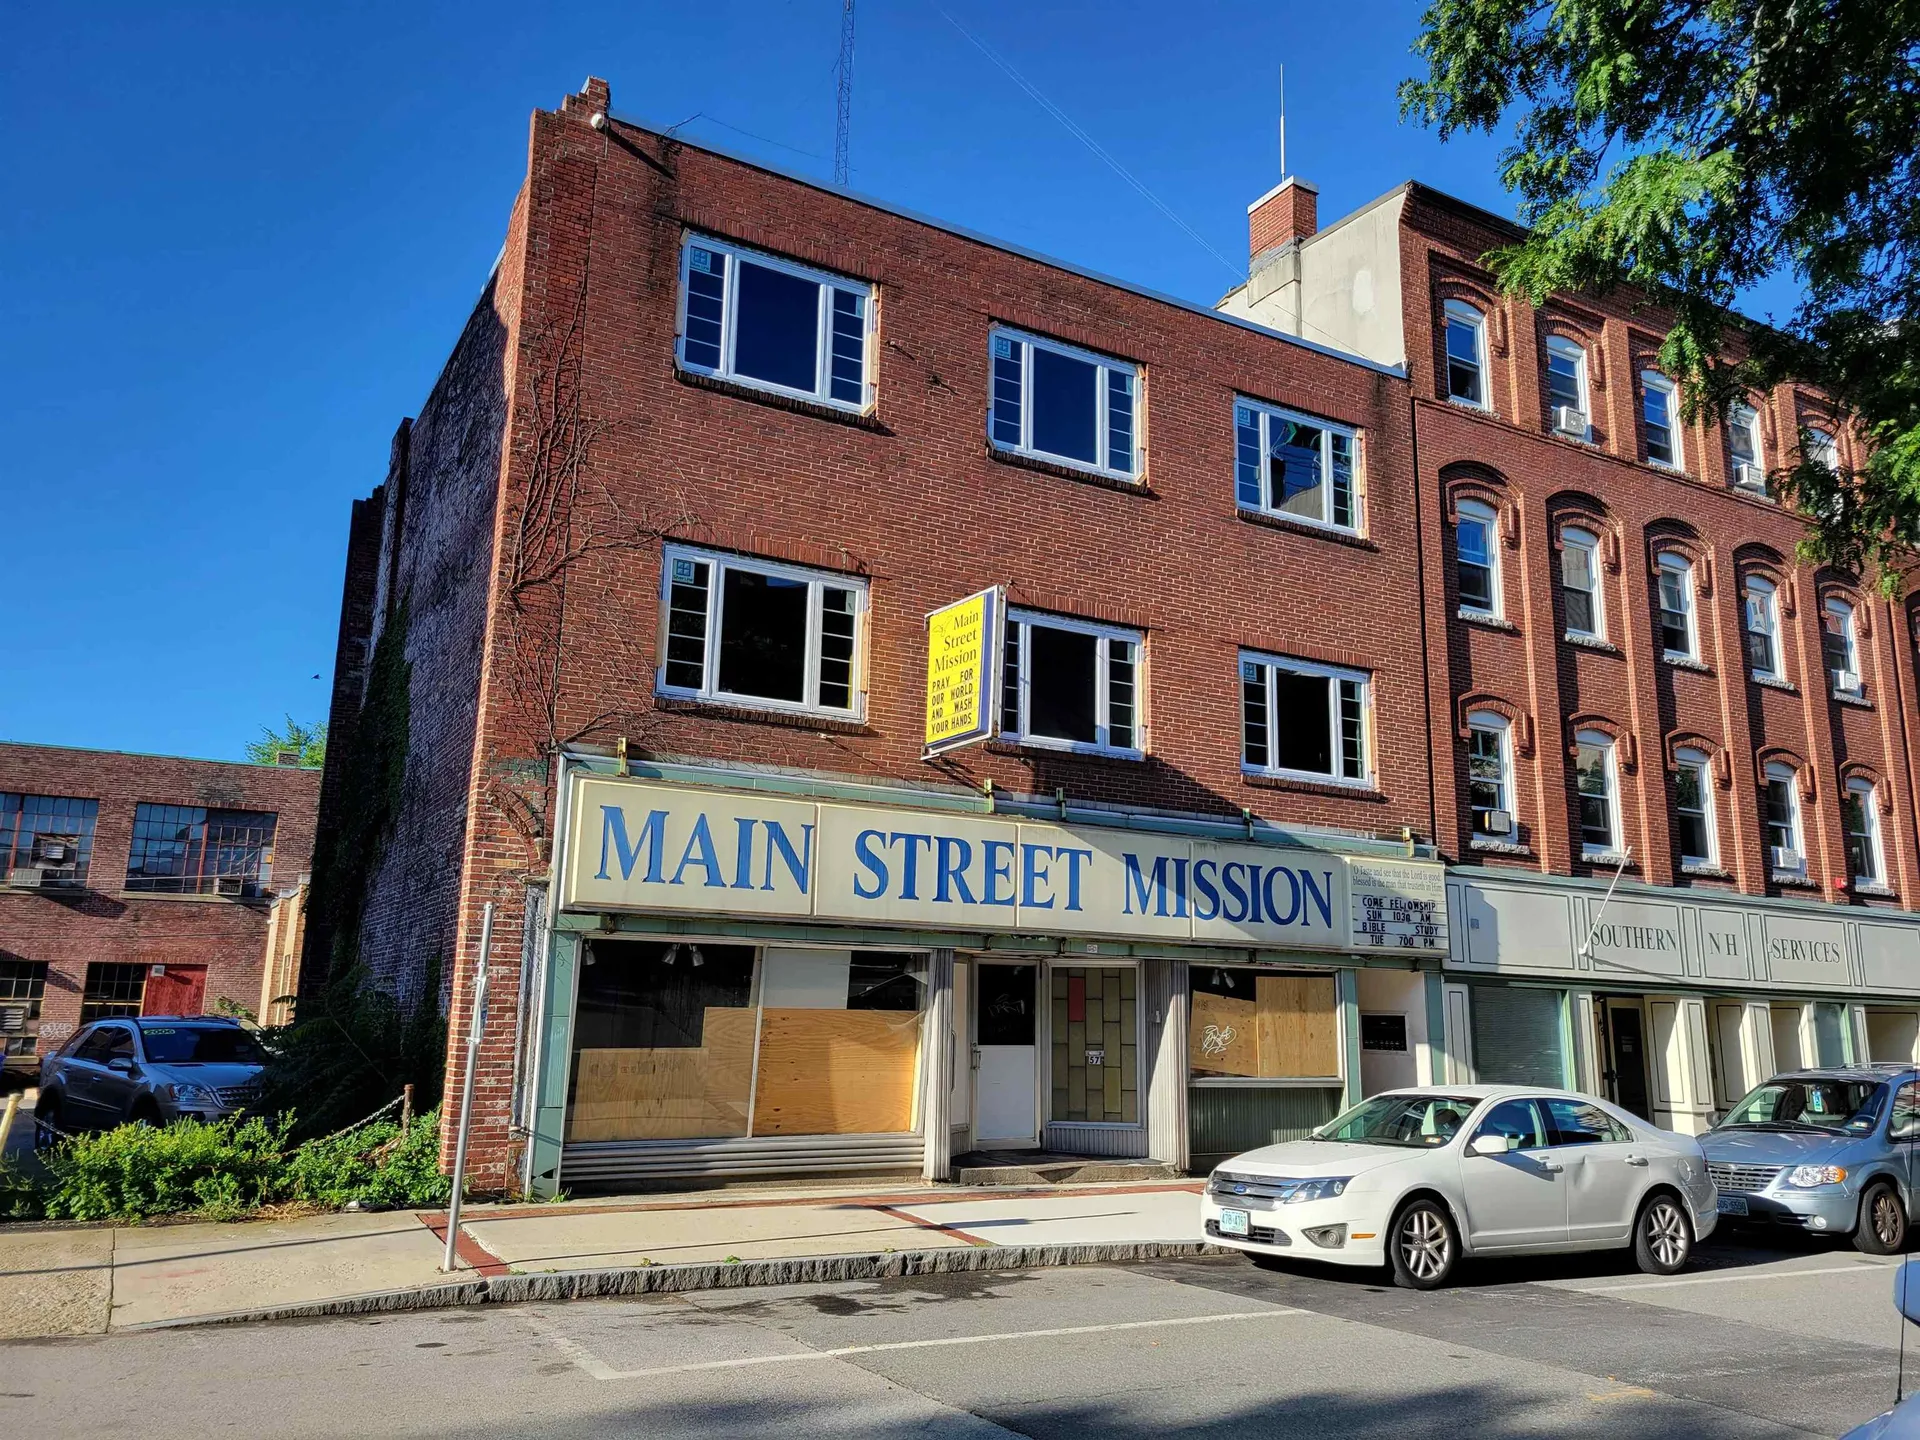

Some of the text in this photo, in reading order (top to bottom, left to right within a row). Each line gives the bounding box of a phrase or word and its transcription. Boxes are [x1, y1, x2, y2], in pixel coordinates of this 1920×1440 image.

[953, 611, 979, 631] Main
[944, 629, 977, 652] Street
[934, 648, 977, 674] Mission
[932, 668, 974, 693] PRAY FOR
[932, 685, 973, 707] OUR WORLD
[932, 699, 973, 722] AND WASH
[931, 713, 972, 735] YOUR HANDS
[594, 805, 1332, 929] MAIN STREET MISSION
[1362, 897, 1384, 908] COME
[1366, 910, 1382, 920] SUN
[1420, 913, 1431, 923] AM
[1362, 922, 1439, 935] BIBLE STUDY
[1370, 935, 1435, 948] TUE 700 PM
[1591, 922, 1676, 951] SOUTHERN
[1772, 937, 1840, 964] SERVICES
[1089, 1056, 1100, 1064] 57
